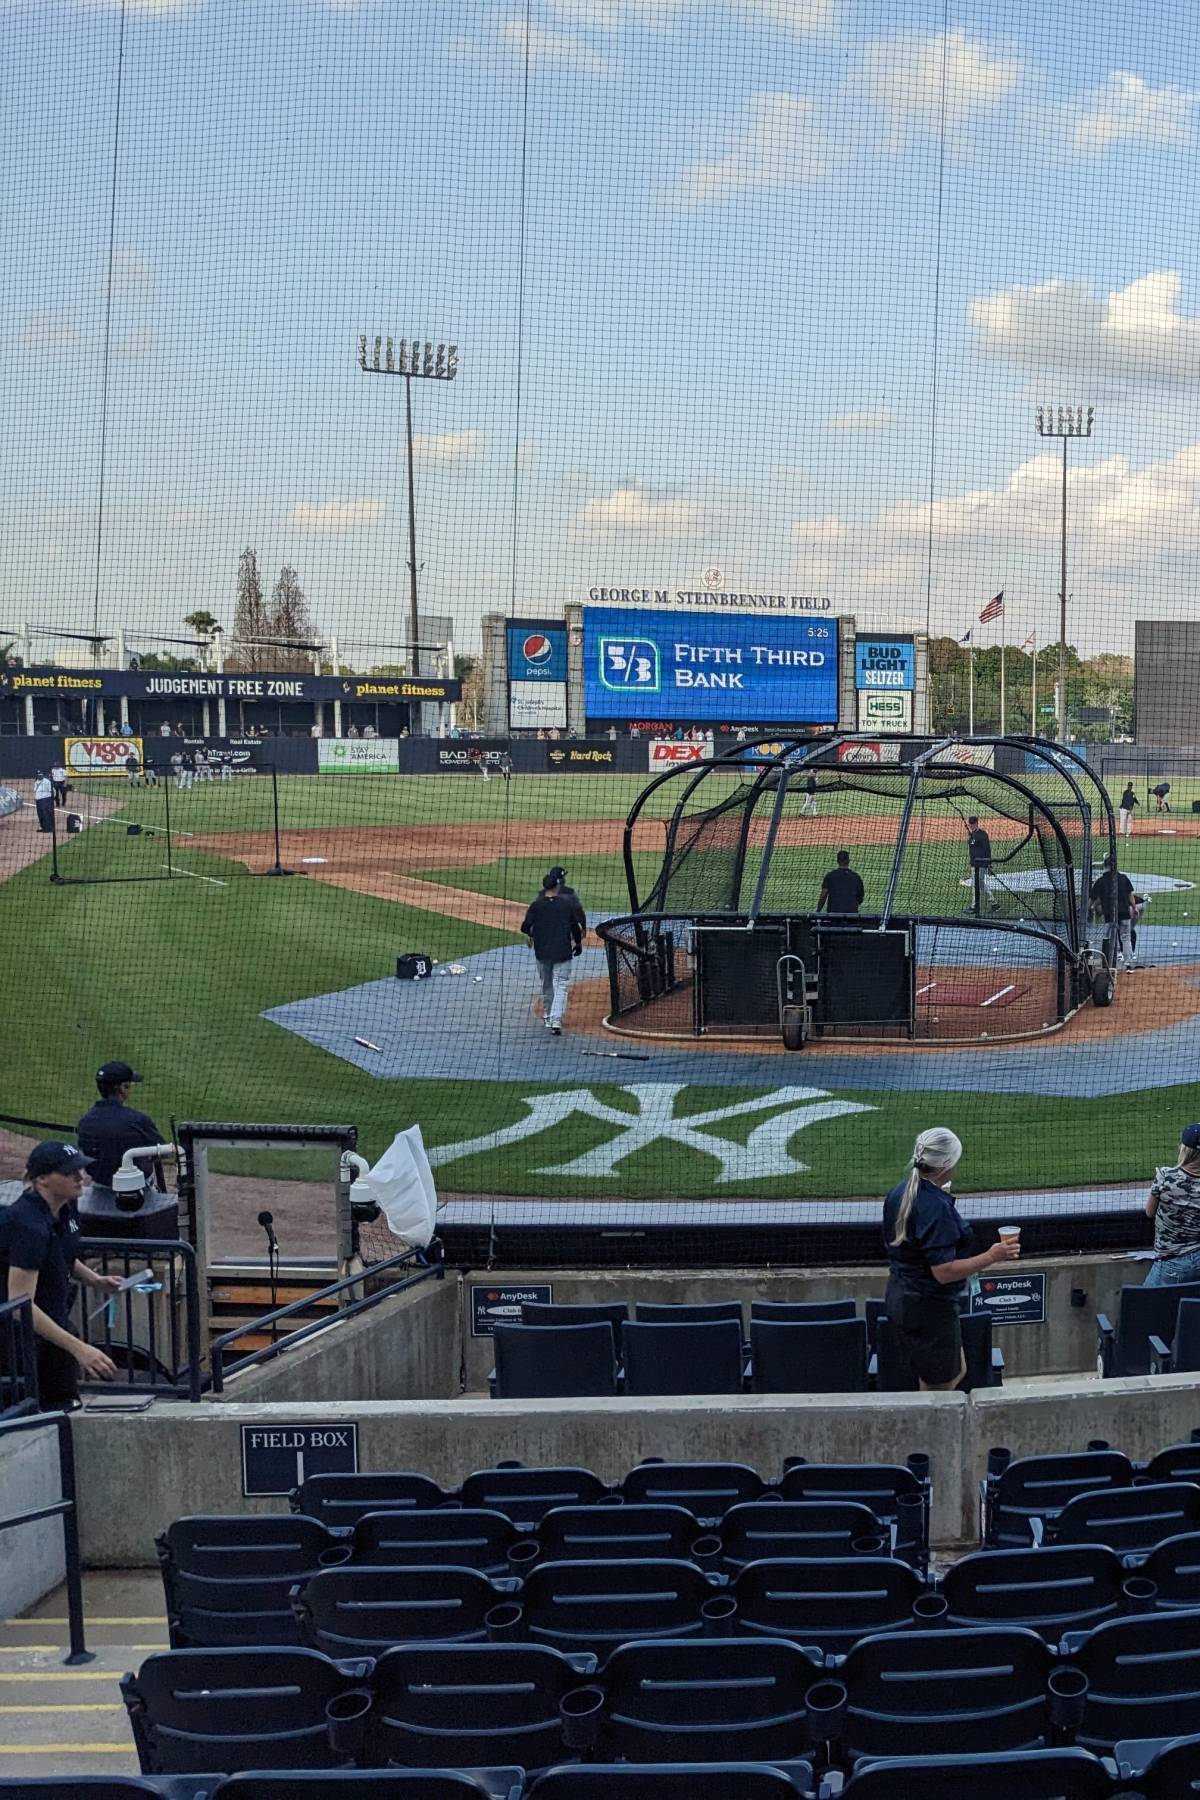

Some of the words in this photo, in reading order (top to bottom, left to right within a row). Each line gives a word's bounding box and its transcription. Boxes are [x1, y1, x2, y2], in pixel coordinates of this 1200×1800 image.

[590, 588, 649, 602] GEORGE
[654, 590, 671, 603] M.
[677, 591, 786, 609] STEINBRENNER
[791, 597, 831, 611] FIELD
[808, 628, 829, 638] 5:25
[868, 647, 902, 659] BUD
[861, 659, 907, 671] LIGHT
[13, 674, 55, 689] planet
[57, 675, 103, 688] fitness
[865, 670, 904, 685] SELTZER
[146, 678, 224, 695] JUDGEMENT
[228, 680, 264, 695] FREE
[267, 681, 304, 697] ZONE
[356, 683, 399, 696] planet
[401, 684, 445, 696] fitness
[870, 702, 900, 711] HESS
[629, 722, 673, 731] MORGAN
[351, 746, 369, 754] STAY
[439, 751, 466, 759] BAD
[570, 750, 592, 760] Hard
[592, 750, 612, 762] Rock
[653, 745, 705, 760] DEX
[996, 1280, 1032, 1291] AnyDesk
[500, 1292, 538, 1302] AnyDesk
[251, 1433, 305, 1448] FIELD
[310, 1431, 348, 1447] BOX
